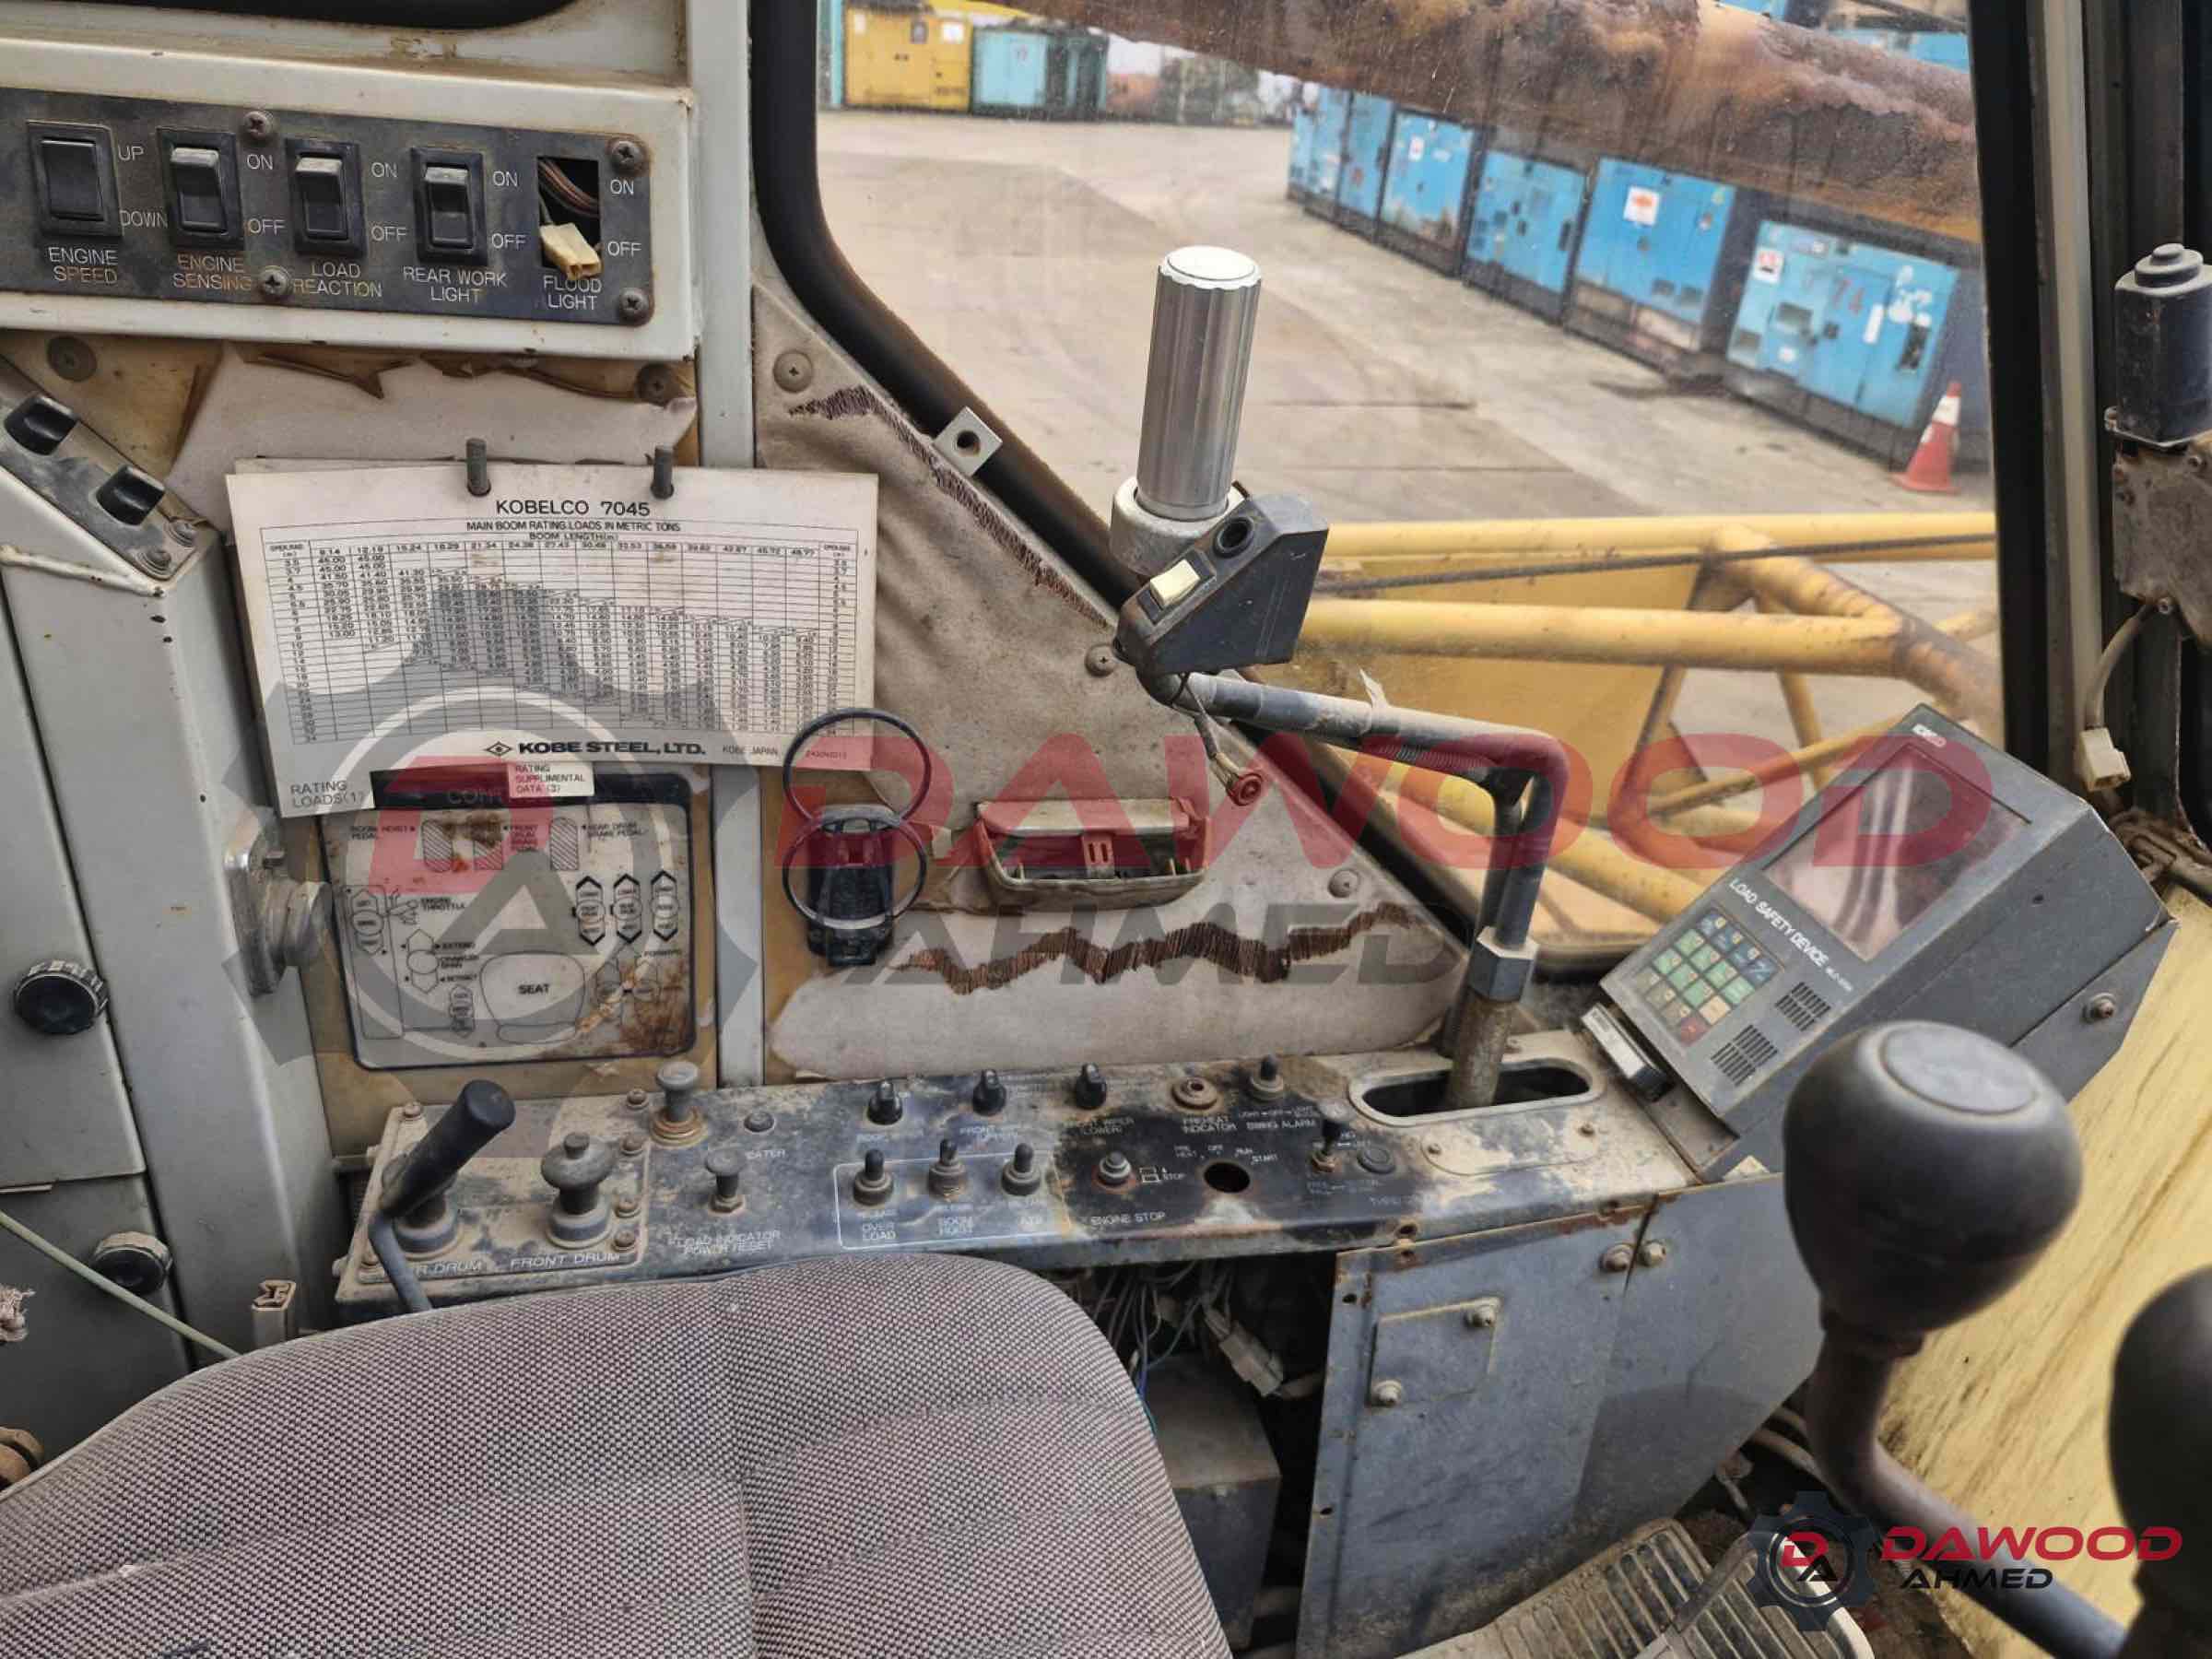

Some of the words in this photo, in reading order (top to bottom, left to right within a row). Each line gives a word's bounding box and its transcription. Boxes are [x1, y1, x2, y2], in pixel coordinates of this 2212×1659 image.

[117, 147, 144, 161] UP
[246, 154, 274, 171] ON
[371, 162, 397, 178] ON
[493, 172, 518, 187] ON
[609, 180, 634, 195] ON
[119, 209, 168, 229] DOWN
[248, 218, 285, 235] OFF
[371, 226, 407, 242] OFF
[491, 233, 526, 250] OFF
[48, 246, 118, 265] ENGINE
[607, 241, 642, 257] OFF
[177, 253, 245, 274] ENGINE
[312, 262, 360, 279] LOAD
[53, 265, 118, 285] SPEED
[172, 272, 253, 292] SENSING
[403, 265, 452, 285] REAR
[457, 271, 508, 288] WORK
[292, 279, 382, 299] REACTION
[543, 276, 603, 295] FLOOD
[430, 287, 483, 304] LIGHT
[547, 293, 598, 311] LIGHT
[496, 500, 589, 514] KOBELCO
[601, 501, 650, 516] 7045
[467, 521, 493, 531] MAIN
[496, 521, 526, 531] BOOM
[529, 521, 566, 531] RATING
[569, 521, 601, 531] LOADS
[605, 522, 614, 531] IN
[617, 522, 653, 532] METRIC
[656, 522, 680, 532] TONS
[519, 742, 582, 754] KOBE
[586, 742, 662, 757] STEEL,
[664, 743, 707, 755] LTD.
[290, 780, 347, 796] RATING
[1729, 877, 1759, 904] LOAD
[1755, 900, 1796, 935] SAFETY
[1789, 931, 1830, 968] DEVICE
[518, 983, 550, 995] SEAT
[1090, 1212, 1132, 1226] ENGINE
[1135, 1210, 1166, 1223] STOP
[432, 1260, 483, 1276] DRUM
[510, 1254, 568, 1270] FRONT
[573, 1252, 620, 1266] DRUM
